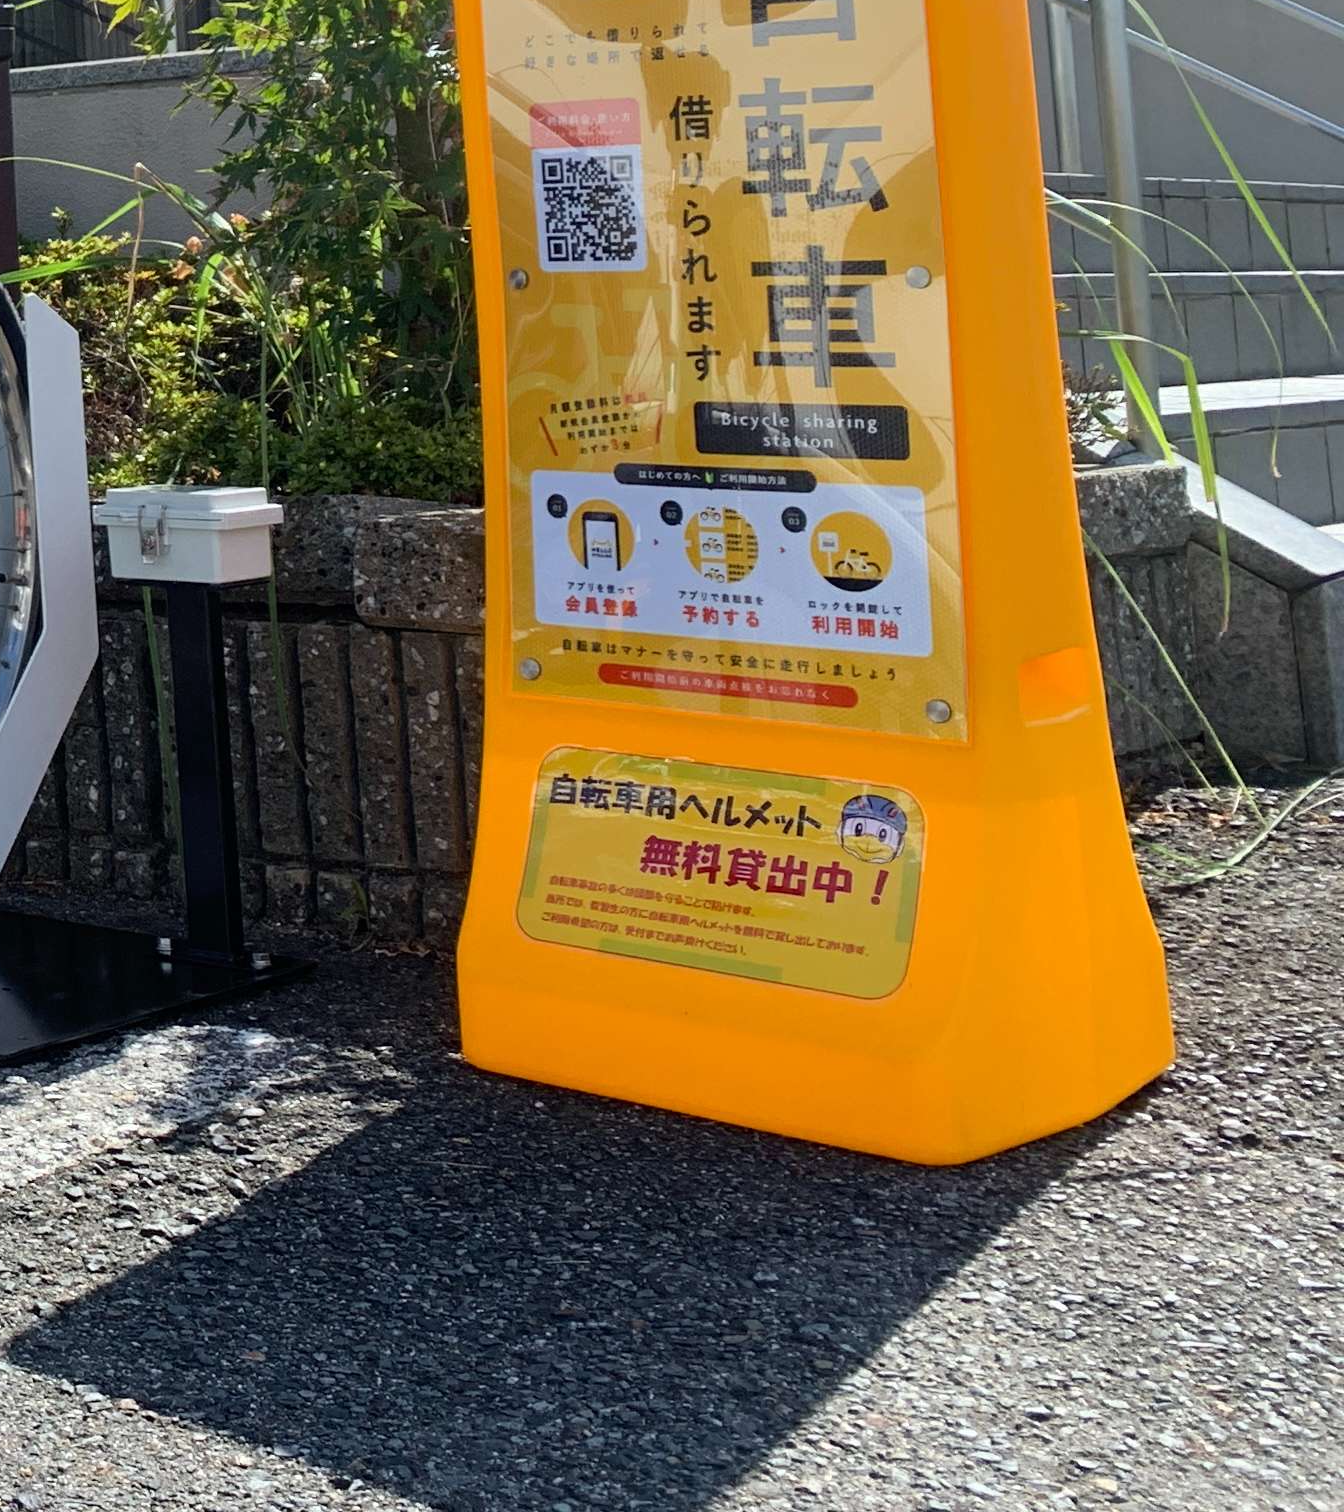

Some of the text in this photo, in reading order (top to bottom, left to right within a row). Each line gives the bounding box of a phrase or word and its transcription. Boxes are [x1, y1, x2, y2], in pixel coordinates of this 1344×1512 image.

[524, 21, 709, 48] どこでも借りられて
[669, 94, 721, 382] 借りられます
[720, 411, 880, 435] Bicycle sharing
[762, 435, 835, 450] station
[638, 470, 702, 482] はじめての方へ
[565, 594, 639, 619] 会員登録
[682, 604, 761, 628] 予約する
[811, 614, 901, 640] 利用開始
[562, 638, 897, 681] 自転車はマナーを守って安全に走行しましょう
[548, 772, 822, 837] 自転車用ヘルメット
[639, 833, 890, 907] 無料貸出中！
